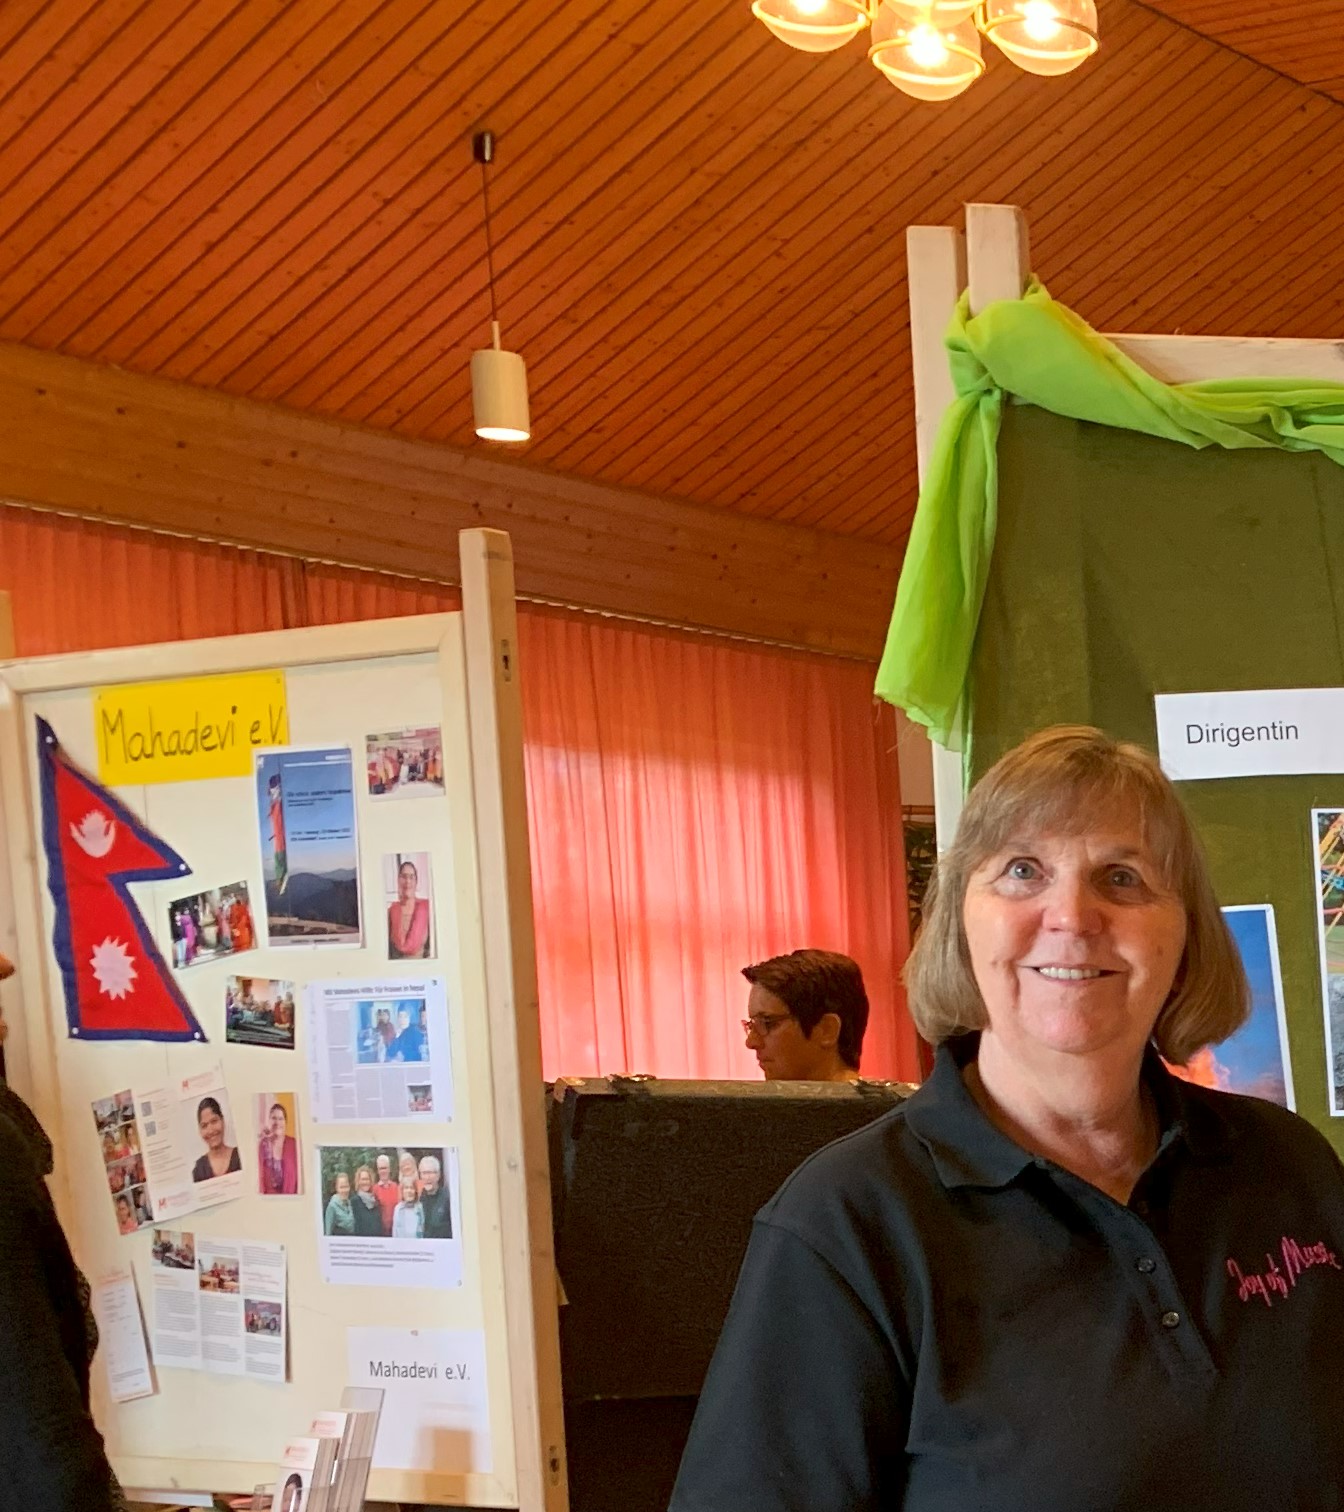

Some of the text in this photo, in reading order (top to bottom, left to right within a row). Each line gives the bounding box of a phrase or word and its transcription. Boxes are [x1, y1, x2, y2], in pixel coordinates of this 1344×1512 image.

[102, 703, 284, 764] Mahadevi e.V.
[1185, 720, 1300, 749] Dirigentin
[1226, 1257, 1272, 1308] Joy
[1281, 1235, 1342, 1287] Music
[369, 1360, 471, 1381] Mahadevi e.V.
